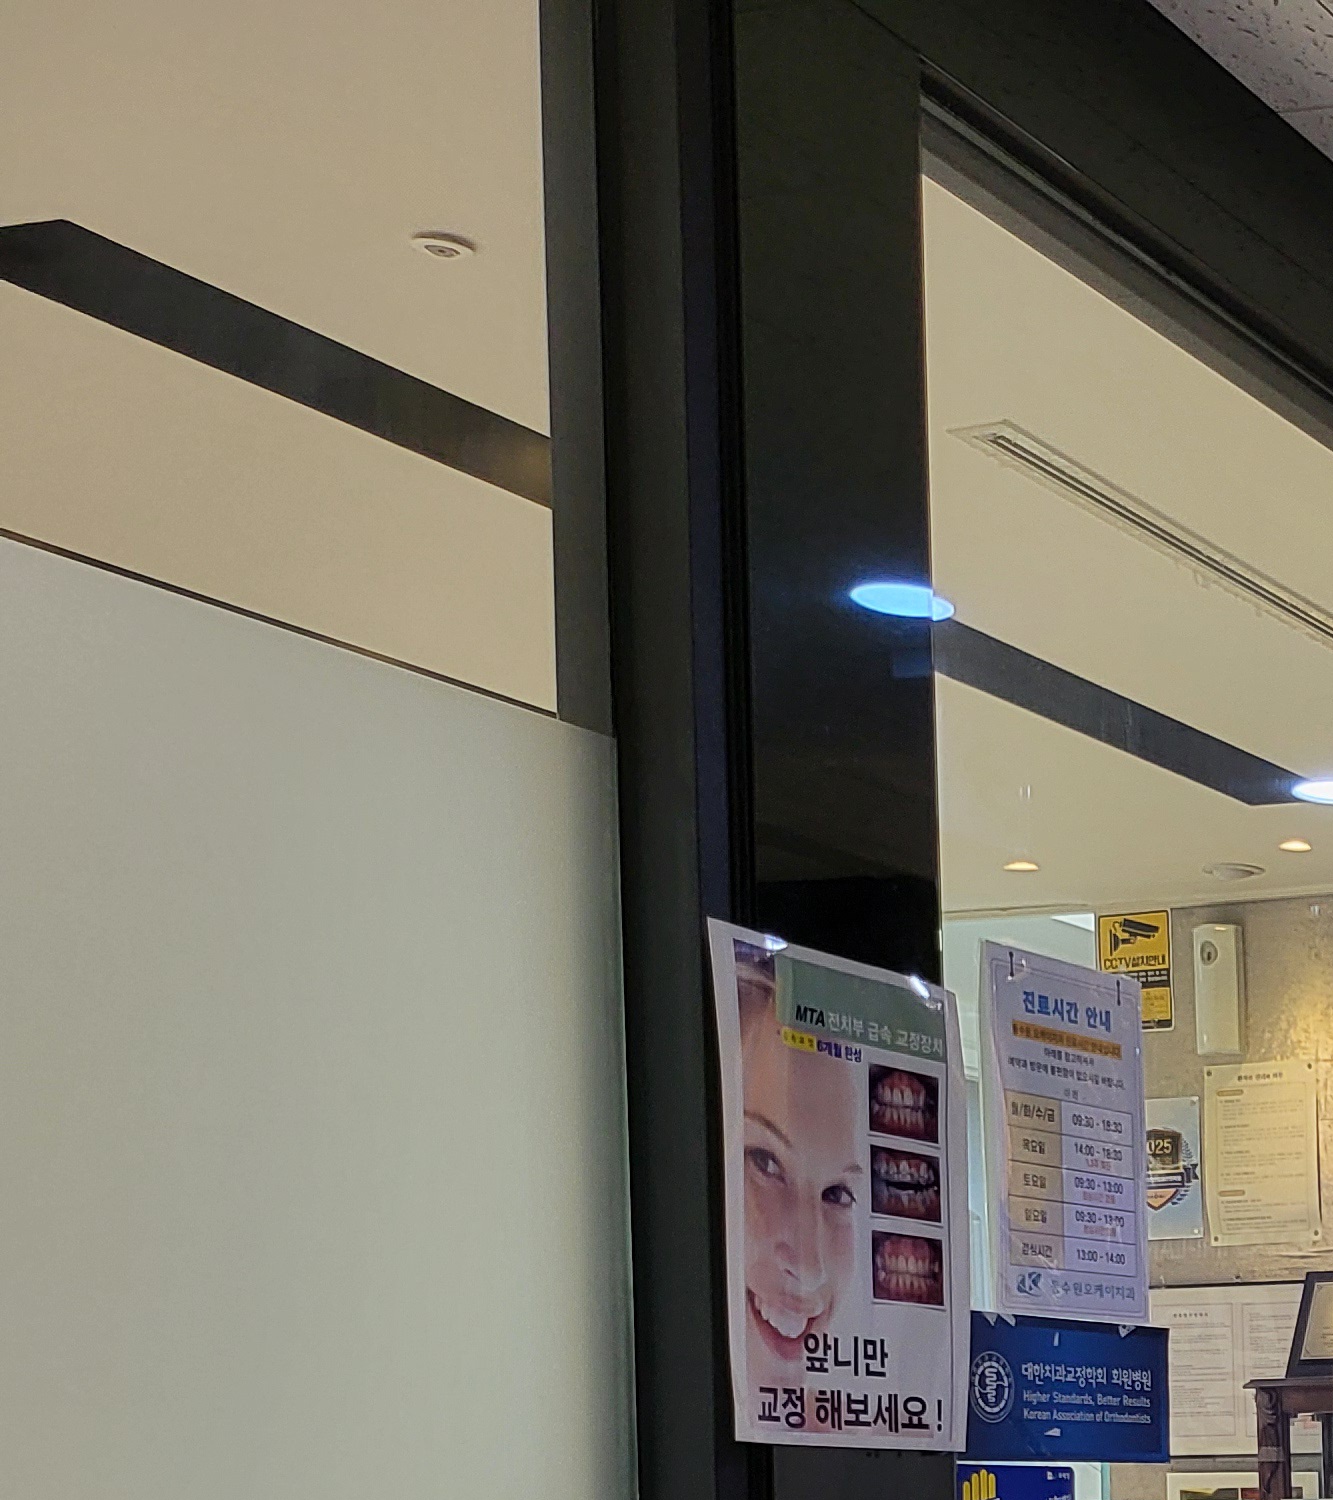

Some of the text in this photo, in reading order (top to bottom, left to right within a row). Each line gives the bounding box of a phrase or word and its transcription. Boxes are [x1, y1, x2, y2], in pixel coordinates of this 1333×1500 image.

[795, 1005, 825, 1027] MTA
[1023, 990, 1111, 1033] 진료시간 안내
[1146, 1138, 1173, 1155] 025
[1023, 1173, 1046, 1189] 토요일
[804, 1333, 889, 1378] 앞니만
[1022, 1362, 1151, 1391] 대한치과교정학회 회원병원
[758, 1386, 806, 1429] 교정
[1023, 1390, 1050, 1405] Higher
[1097, 1394, 1120, 1405] Better
[1123, 1395, 1150, 1408] Results
[1023, 1408, 1151, 1424] Korean Association of Orthodontists
